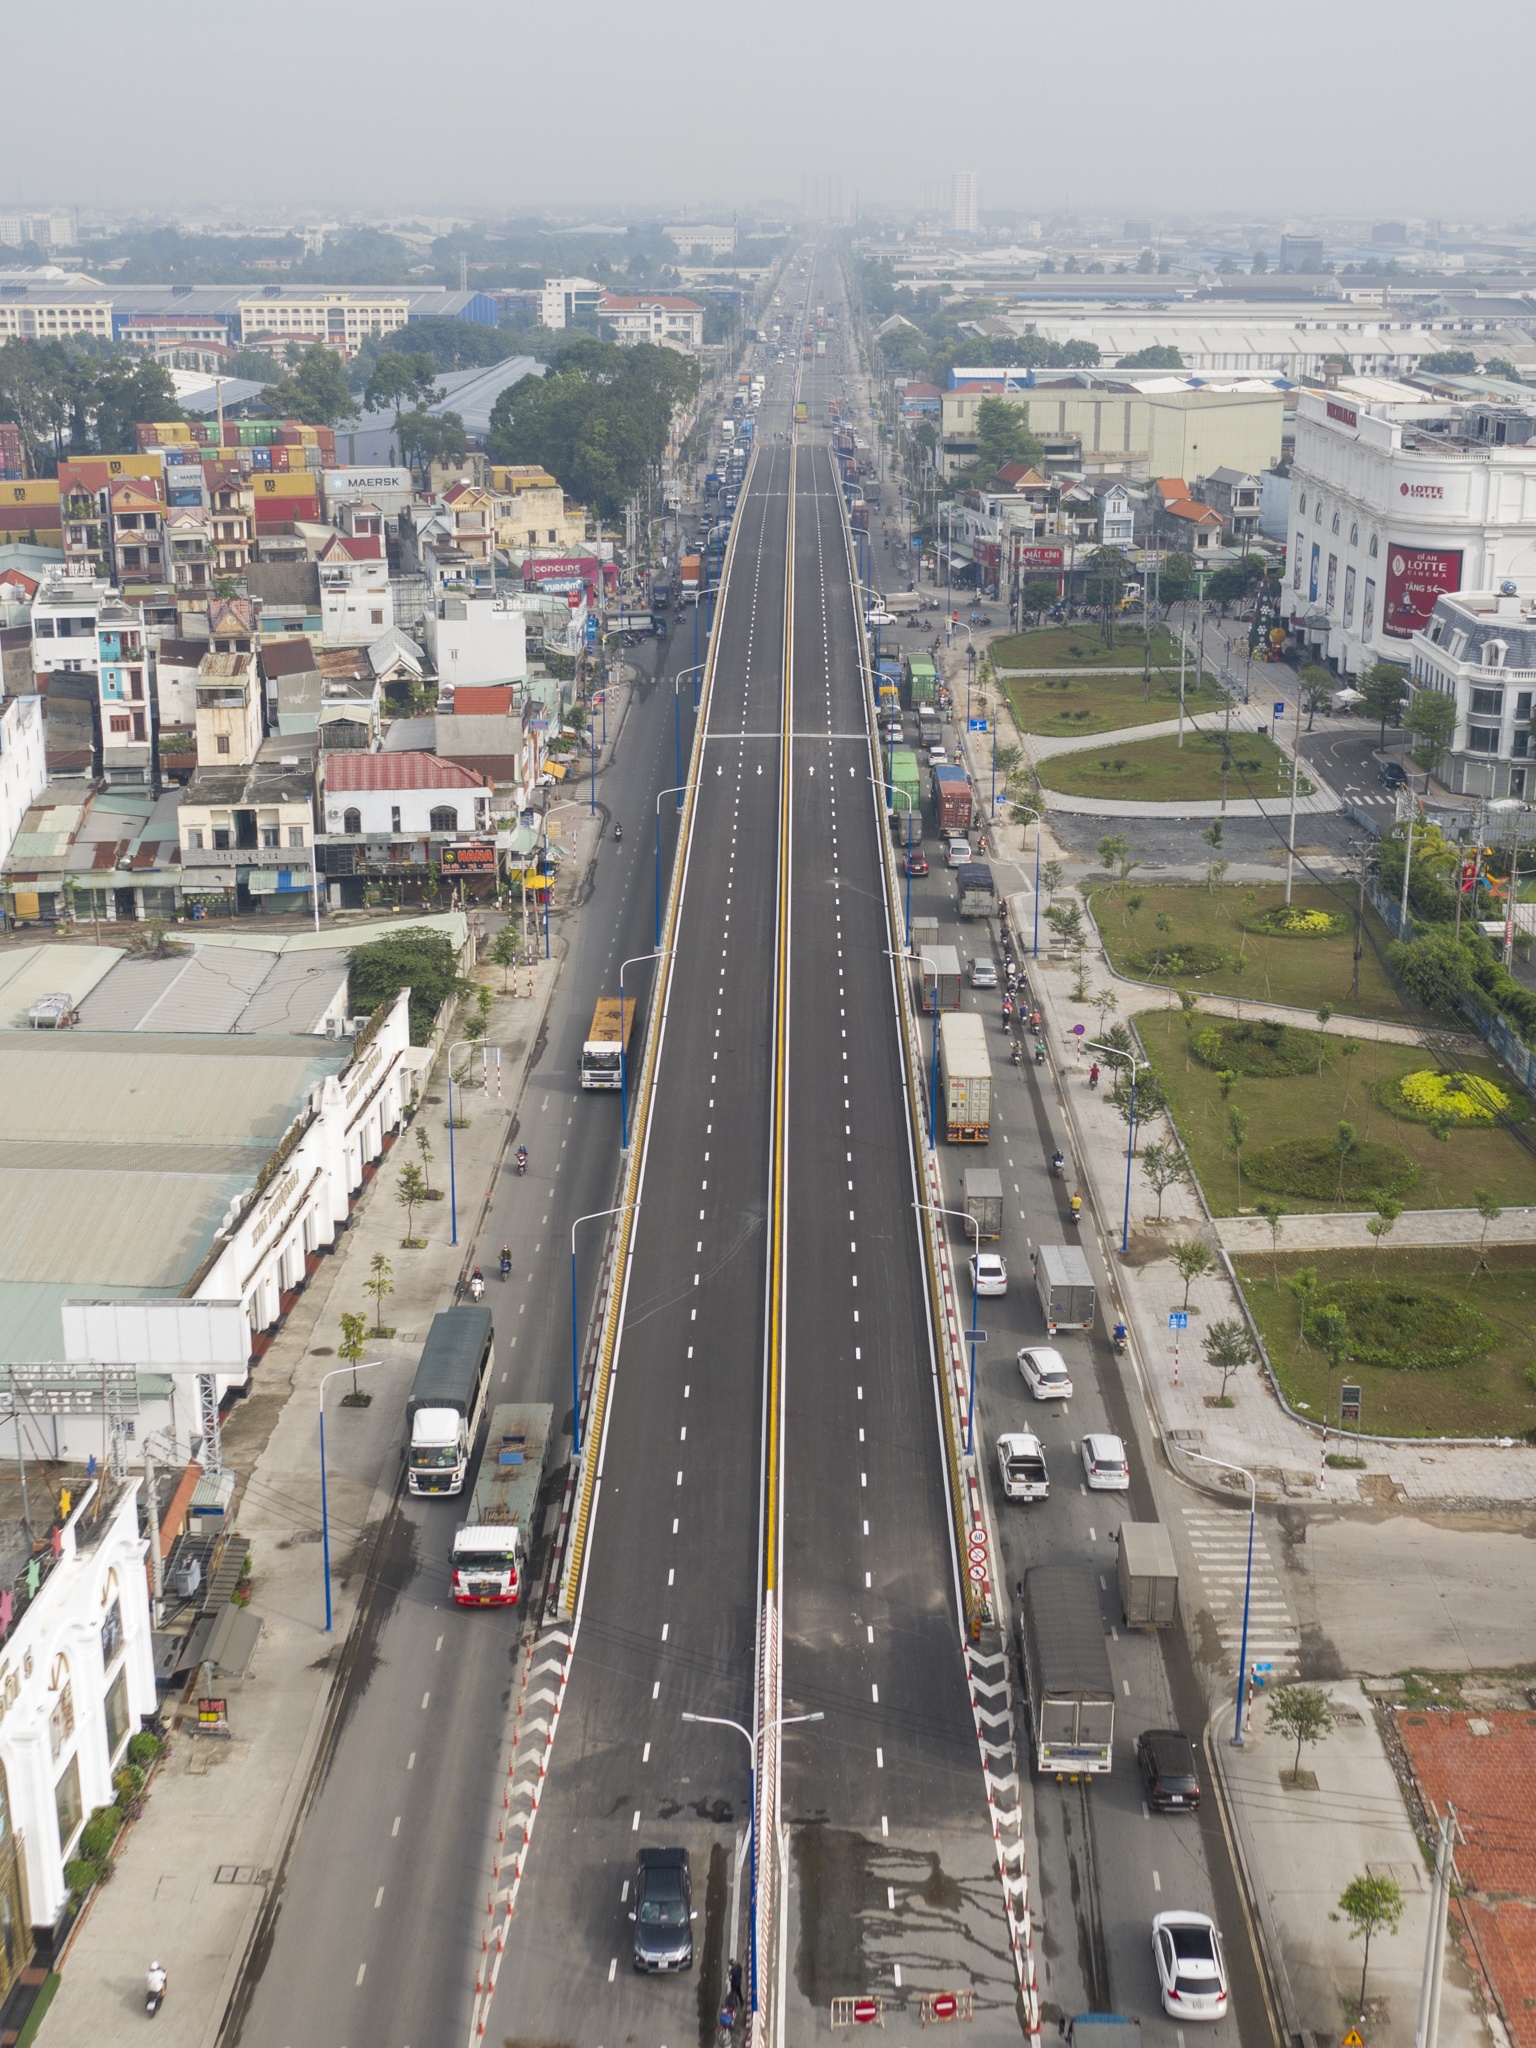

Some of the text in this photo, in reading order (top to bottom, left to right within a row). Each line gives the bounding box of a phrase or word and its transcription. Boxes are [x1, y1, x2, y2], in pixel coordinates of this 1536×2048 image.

[348, 477, 399, 487] MAERSK
[1411, 485, 1444, 494] LOTTE
[1408, 561, 1447, 571] LOTTE
[1407, 570, 1447, 578] CINEMA
[457, 849, 493, 862] HANA
[974, 1533, 983, 1541] 60
